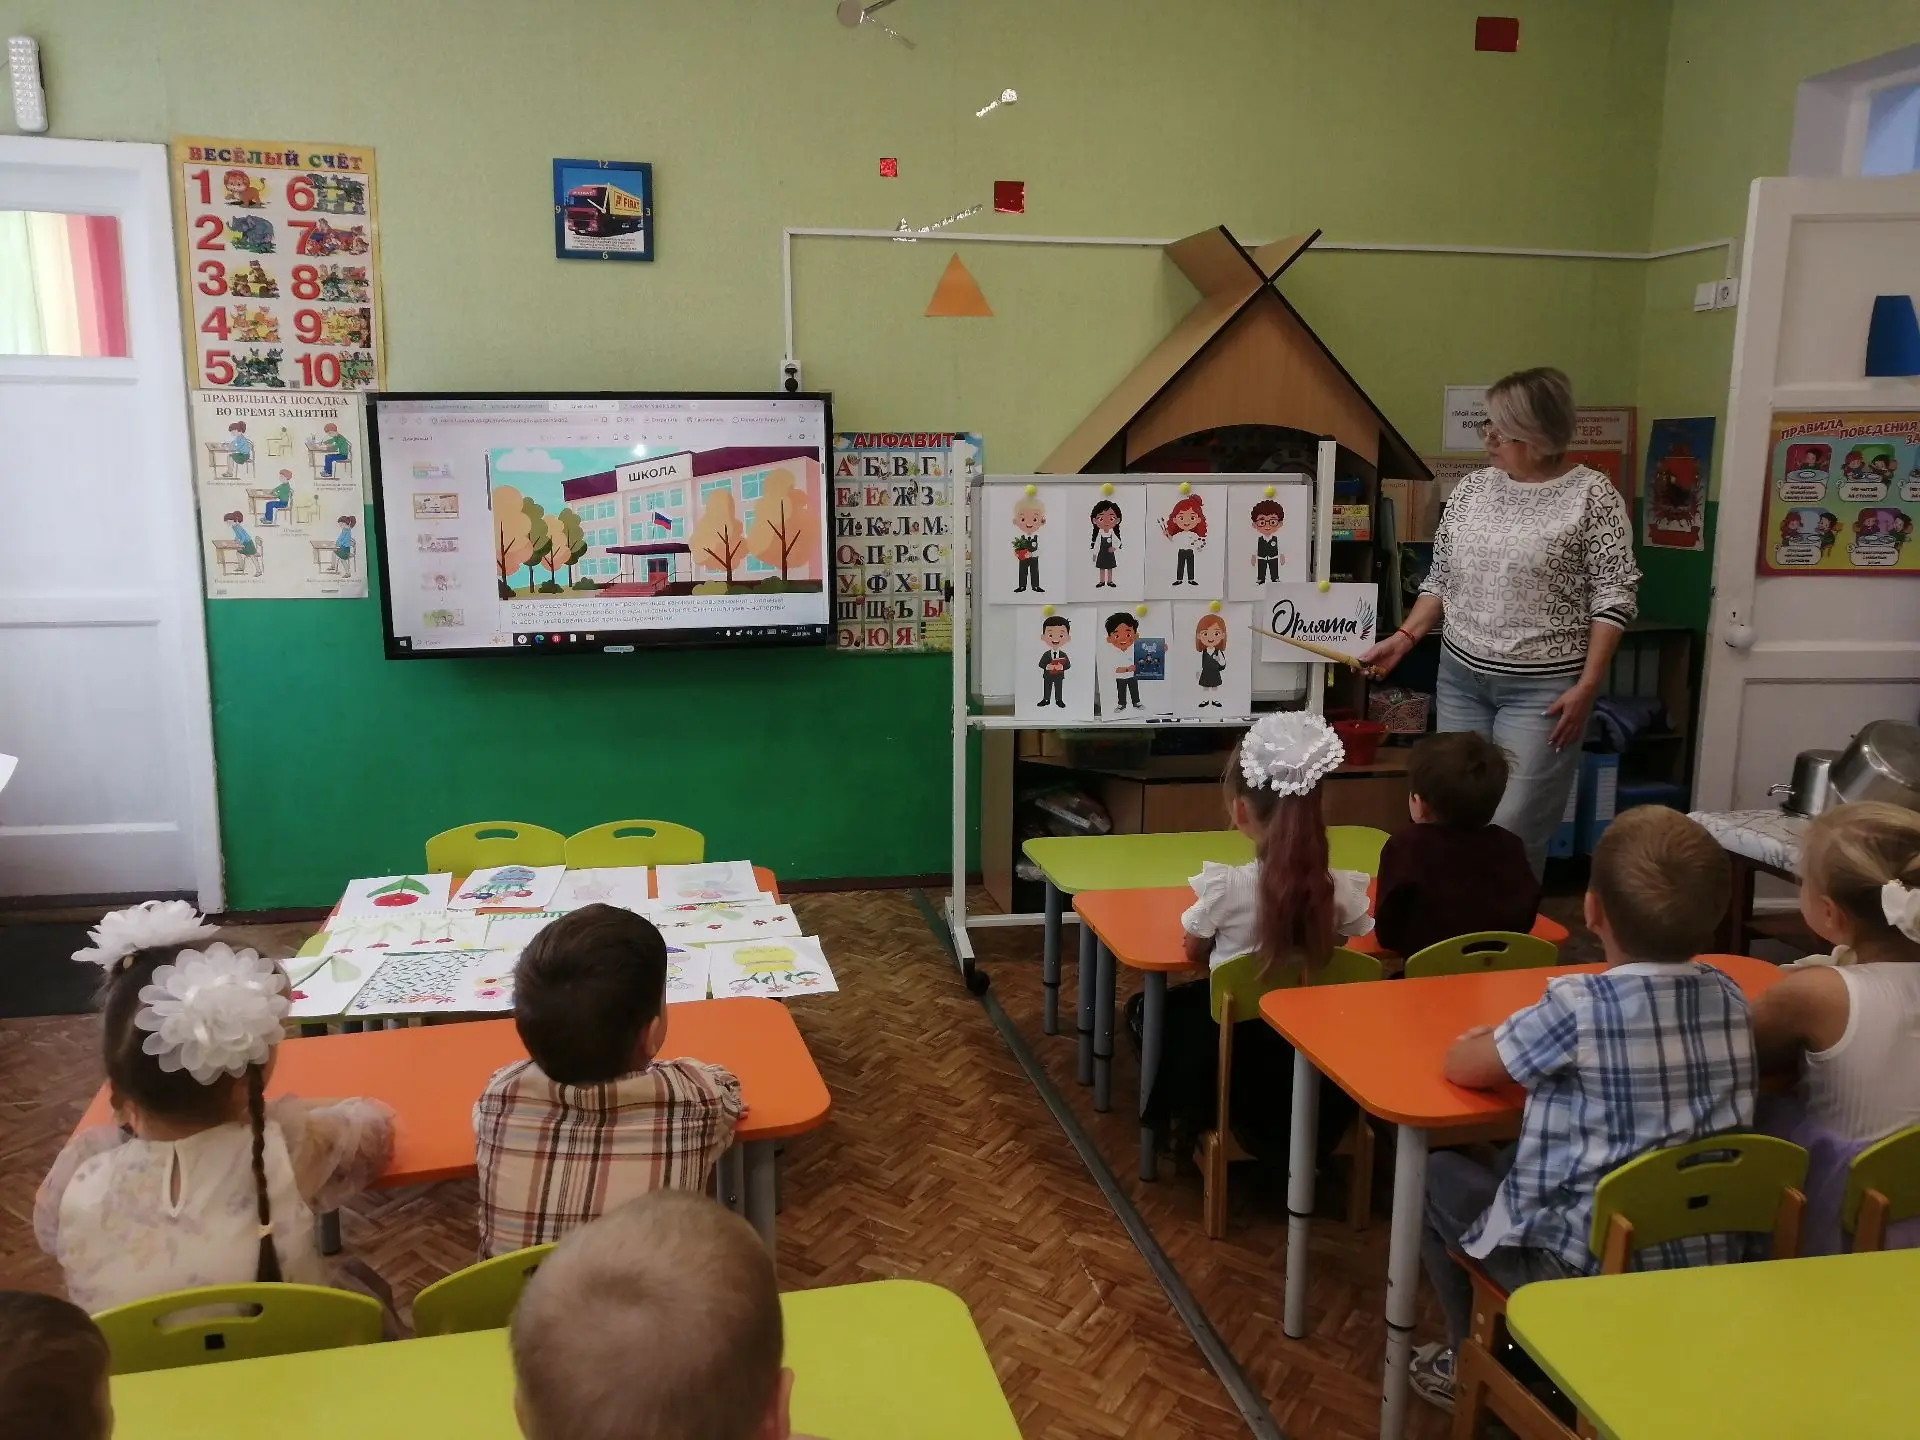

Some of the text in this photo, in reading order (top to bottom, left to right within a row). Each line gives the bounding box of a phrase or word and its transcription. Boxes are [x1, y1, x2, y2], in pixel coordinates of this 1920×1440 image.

[188, 147, 362, 170] ВЕСЁЛЫЙ СЧЁТ
[598, 160, 608, 168] 12
[192, 170, 211, 204] 1
[287, 176, 315, 212] 6
[555, 206, 561, 214] 9
[646, 208, 650, 216] 3
[195, 215, 225, 251] 2
[288, 220, 317, 254] 7
[602, 252, 608, 260] 6
[198, 260, 228, 296] 3
[292, 264, 320, 300] 8
[202, 306, 232, 341] 4
[293, 309, 322, 344] 9
[206, 350, 234, 385] 5
[294, 353, 340, 388] 10
[203, 394, 350, 406] ПРАВИЛЬНАЯ ПОСАДКА
[216, 408, 339, 418] ВО ВРЕМЯ ЗАНЯТИЙ
[1576, 425, 1602, 436] ГЕРБ
[1781, 418, 1918, 440] ПРАВИЛА ПОВЕДЕНИЯ
[854, 432, 954, 448] АЛФАВИТ
[628, 465, 677, 482] ШКОЛА
[836, 457, 936, 476] А Б В Г
[836, 488, 850, 507] Е
[893, 487, 915, 506] Ж
[922, 486, 934, 506] З
[1475, 494, 1530, 506] CLASS
[1489, 484, 1566, 498] FASHION
[1472, 514, 1551, 529] FASHION
[1512, 506, 1572, 522] JOSSE
[837, 512, 942, 537] Й К Л М
[1457, 524, 1512, 534] CLASS
[837, 544, 940, 564] О П Р С
[1456, 544, 1536, 563] FASHION
[1450, 558, 1576, 586] CLASS FASHION
[838, 572, 942, 595] У Ф Х Ц
[1490, 575, 1546, 592] JOSSE
[838, 602, 858, 619] Ш
[895, 600, 913, 618] Ъ
[923, 600, 944, 618] Ы
[1272, 599, 1357, 638] Орлята
[1504, 603, 1581, 616] FASHION
[1484, 615, 1592, 628] JOSSE CLAS
[839, 629, 854, 648] Э
[867, 628, 888, 646] Ю
[896, 627, 913, 646] Я
